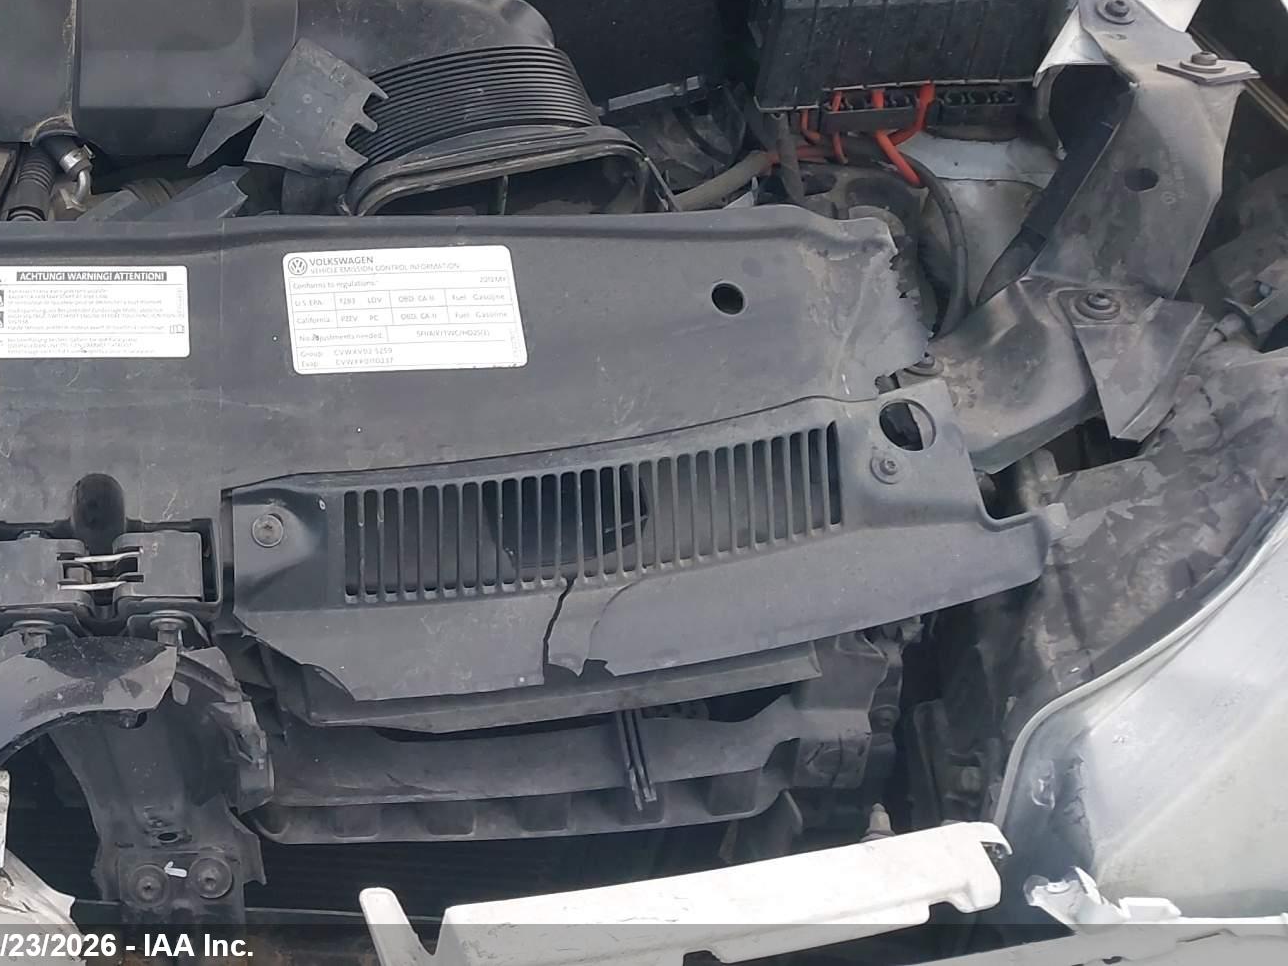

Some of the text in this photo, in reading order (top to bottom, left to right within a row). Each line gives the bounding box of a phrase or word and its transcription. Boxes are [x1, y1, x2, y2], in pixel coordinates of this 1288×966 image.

[309, 255, 374, 266] VOLKSWAGEN
[339, 265, 374, 274] EMISSION
[375, 264, 408, 272] CONTROL
[409, 262, 461, 271] INFORMATION
[19, 271, 165, 282] ACHTUNG! WARNING! ATTENTION!
